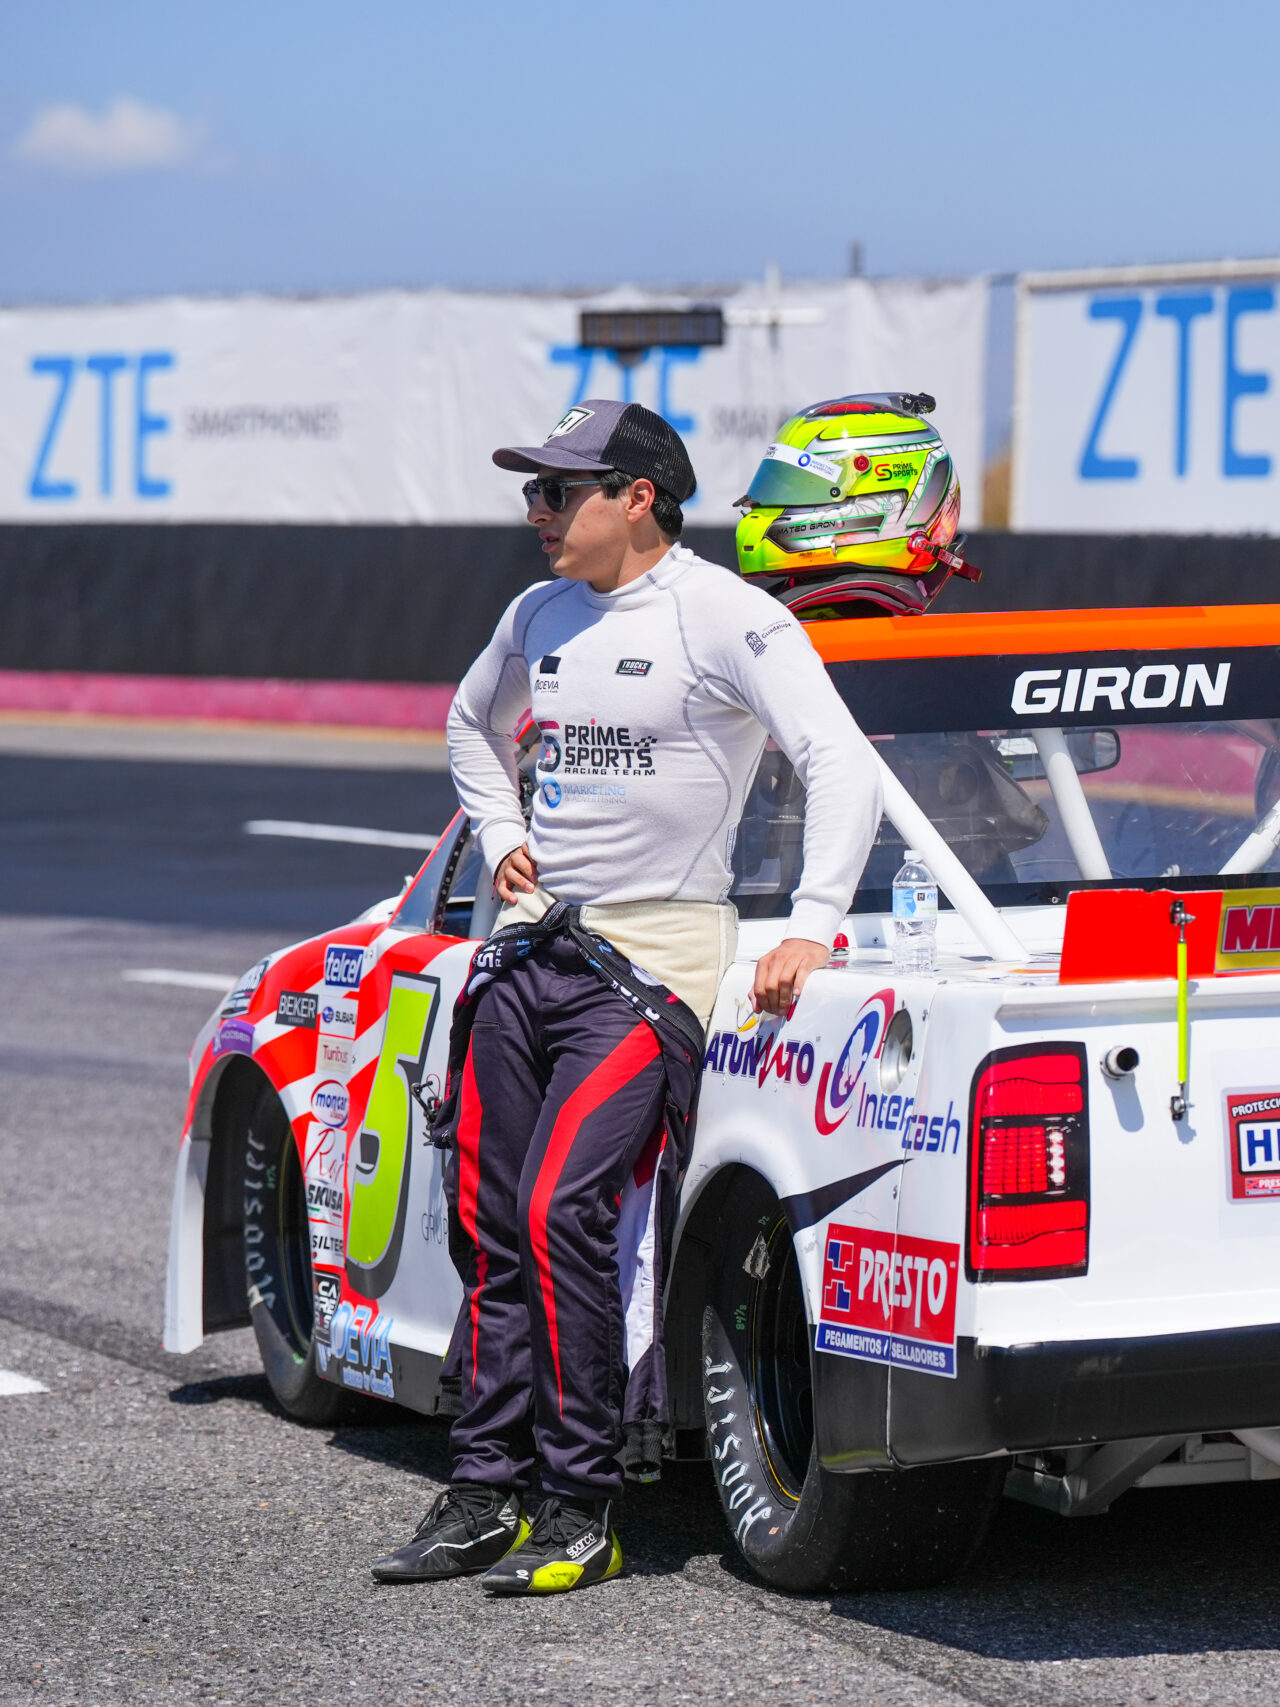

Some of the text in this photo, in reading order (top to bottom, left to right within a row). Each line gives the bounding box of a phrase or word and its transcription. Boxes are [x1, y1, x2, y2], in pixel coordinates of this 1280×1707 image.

[1077, 283, 1277, 481] ZTE
[28, 352, 176, 498] ZTE
[1011, 662, 1231, 715] GIRON
[565, 717, 632, 747] PRIME
[564, 767, 656, 777] RACING TEAM
[565, 746, 653, 769] SPORTS
[326, 951, 363, 984] telcel
[279, 993, 317, 1019] BEKER
[349, 974, 439, 1270] 5
[421, 1212, 448, 1245] GRUP
[858, 1247, 948, 1328] PRESTO
[824, 1329, 882, 1356] PEGAMENTOS
[891, 1344, 946, 1369] SELLADORES
[566, 1532, 598, 1559] sparco
